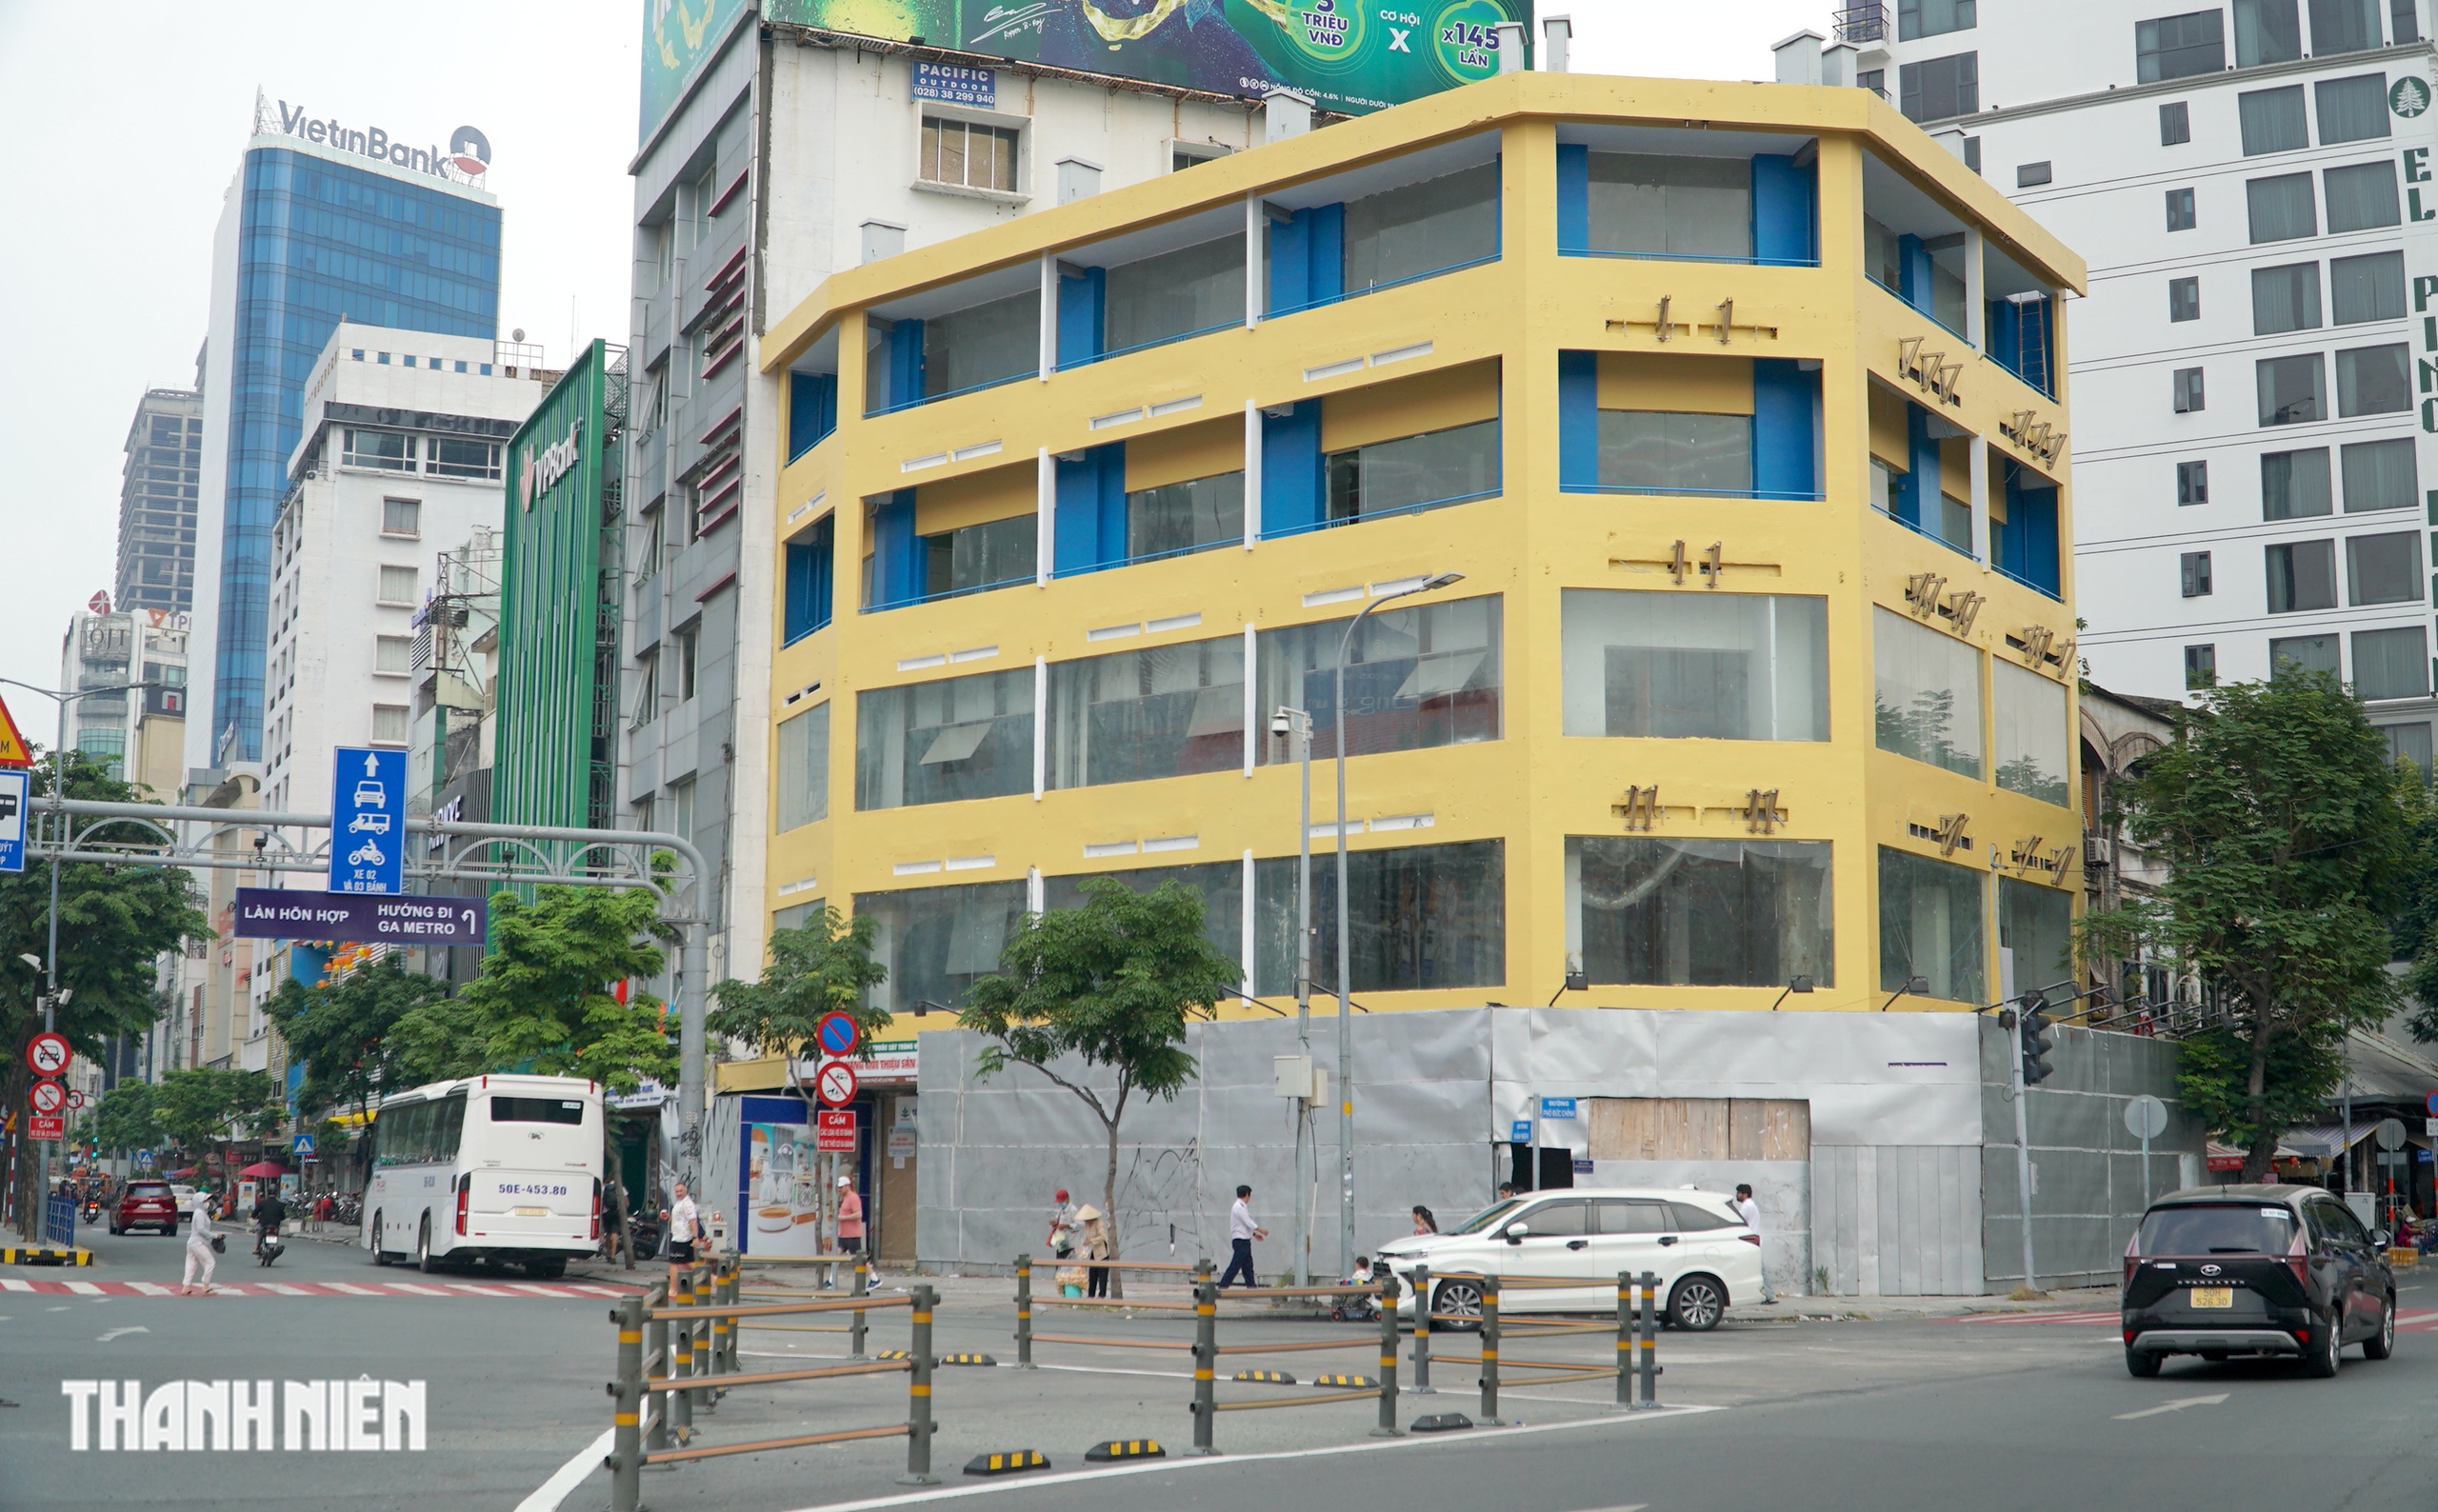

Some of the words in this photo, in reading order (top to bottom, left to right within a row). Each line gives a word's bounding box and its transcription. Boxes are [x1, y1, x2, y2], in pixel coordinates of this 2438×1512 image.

[1302, 11, 1348, 31] TRIỆU
[1380, 10, 1397, 21] CƠ
[1399, 12, 1420, 27] HỘI
[1309, 30, 1344, 47] VNĐ
[1460, 48, 1489, 68] LẦN
[920, 63, 989, 82] PACIFIC
[920, 77, 988, 92] OUTDOOR
[914, 87, 939, 98] (028)
[941, 90, 953, 99] 38
[955, 91, 974, 102] 299
[976, 94, 994, 104] 940
[278, 99, 450, 179] VietinBank
[169, 610, 191, 631] TP
[353, 869, 364, 879] XE
[366, 870, 376, 880] 02
[344, 880, 352, 891] VÀ
[354, 882, 364, 891] 03
[367, 881, 387, 892] BÁNH
[245, 905, 275, 920] LÀN
[279, 905, 314, 922] HỖN
[316, 909, 350, 925] HỢP
[378, 903, 434, 918] HƯỚNG
[437, 906, 453, 919] ĐI
[378, 921, 400, 932] GA
[403, 922, 455, 934] METRO
[38, 1118, 54, 1128] CẤM
[829, 1113, 846, 1124] CẤM
[498, 1184, 567, 1196] 50E-453.80
[2196, 1298, 2228, 1306] 526.30
